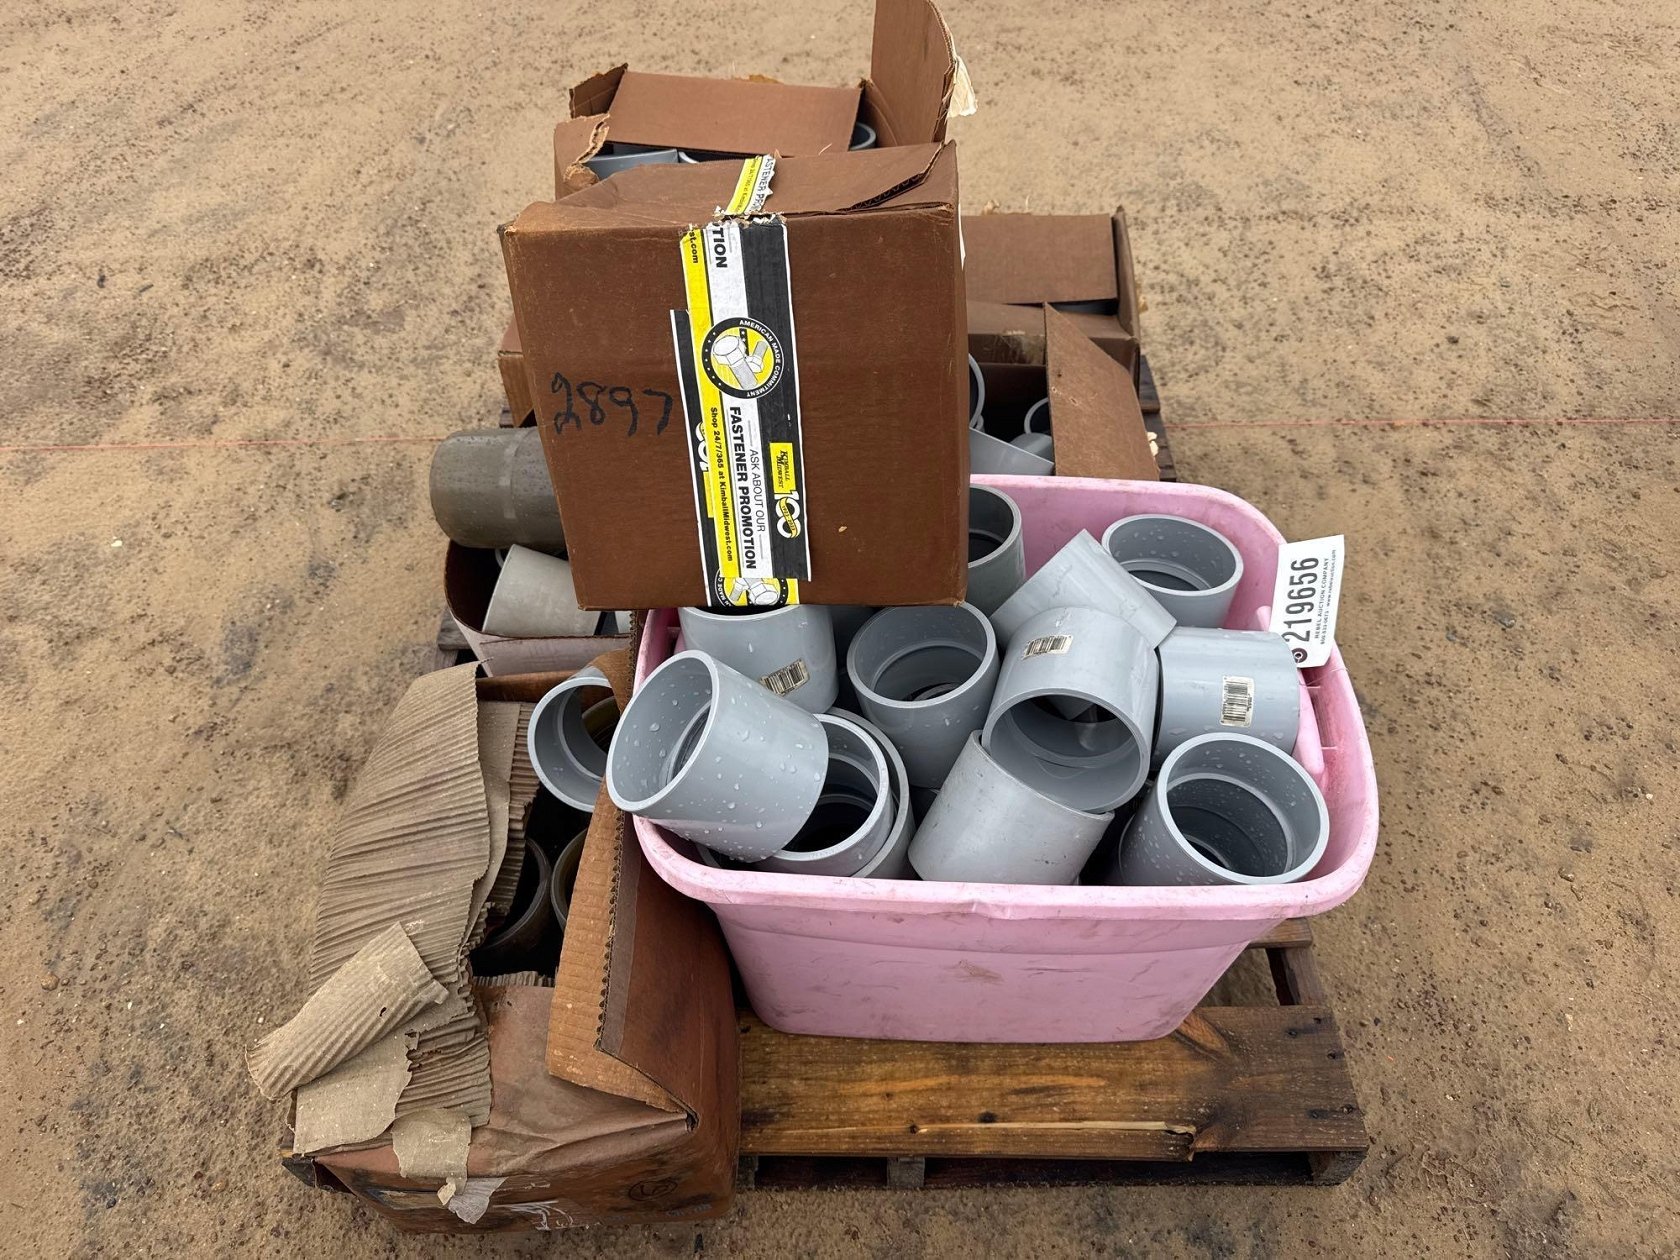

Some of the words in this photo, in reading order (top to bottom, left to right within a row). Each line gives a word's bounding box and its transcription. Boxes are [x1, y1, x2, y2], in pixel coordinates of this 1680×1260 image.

[739, 319, 773, 342] AMERICAN
[771, 342, 781, 364] MADE
[746, 365, 781, 398] COMMITMENT
[551, 372, 674, 437] 2897
[710, 407, 719, 428] Shop
[713, 431, 724, 469] 24/7/365
[730, 406, 749, 482] FASTENER
[749, 449, 760, 470] ASK
[718, 472, 725, 480] at
[751, 473, 764, 508] ABOUT
[719, 482, 733, 562] KimballMidwest.com
[738, 486, 757, 569] PROMOTION
[755, 510, 766, 532] OUR
[1321, 557, 1329, 588] COMPANY
[1281, 557, 1319, 643] 219656
[1318, 589, 1326, 617] AUCTION
[1314, 618, 1322, 639] REBEL
